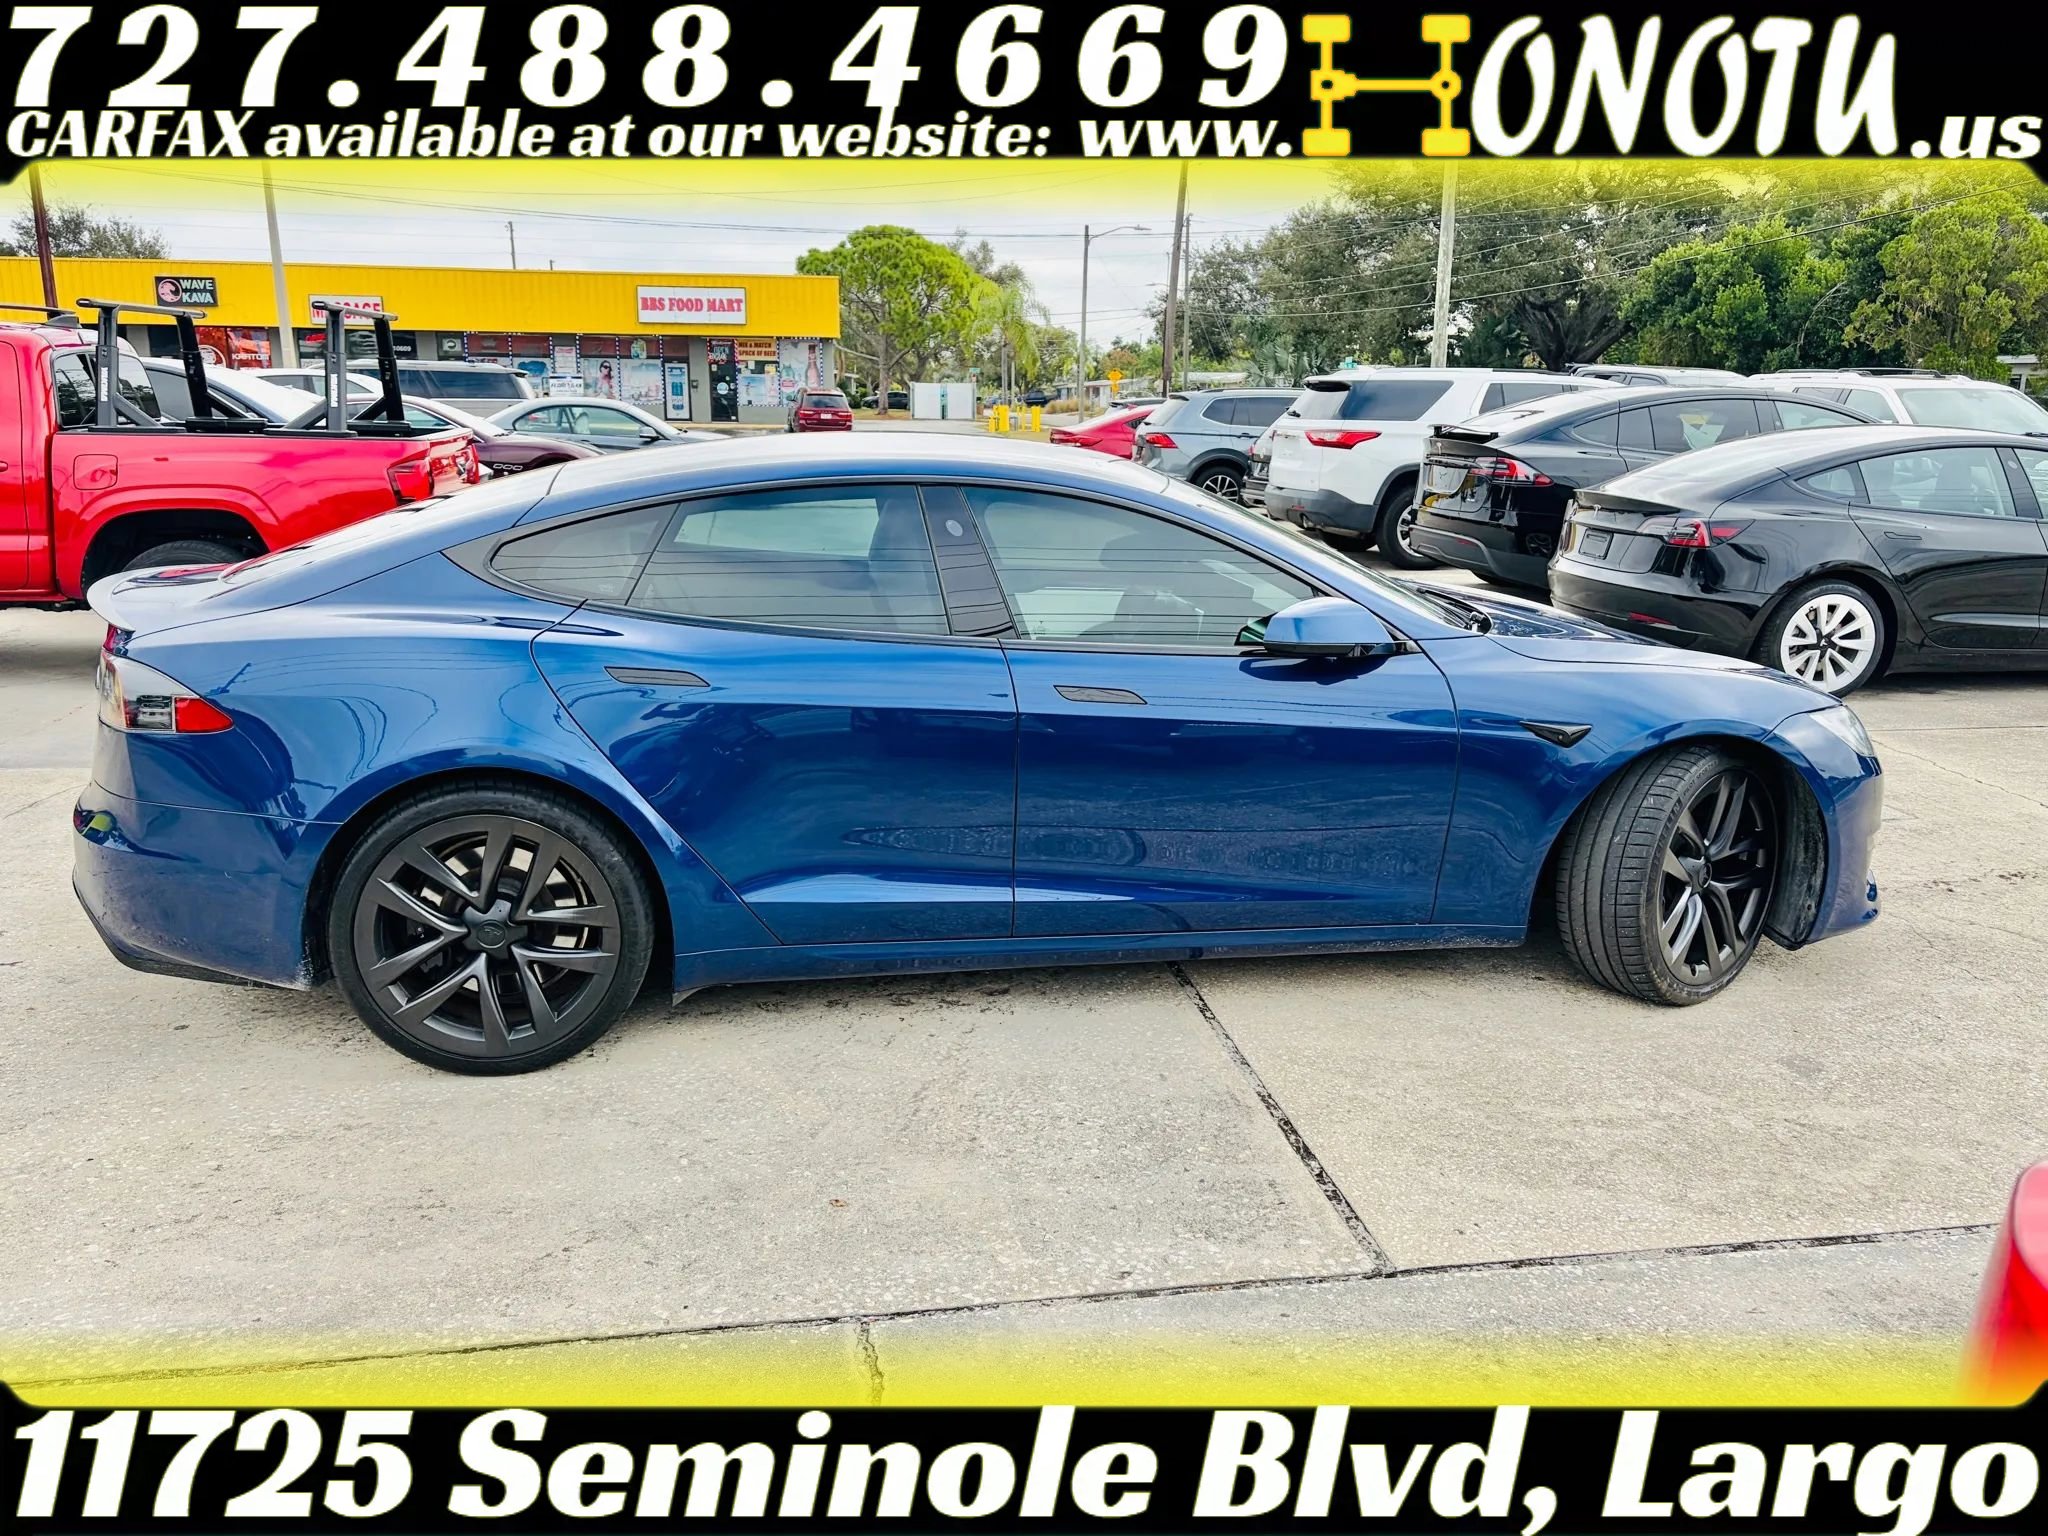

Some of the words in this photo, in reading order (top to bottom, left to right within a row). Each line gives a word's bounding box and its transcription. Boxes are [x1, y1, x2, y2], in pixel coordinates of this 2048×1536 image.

[180, 279, 214, 290] WAVE
[182, 292, 214, 303] KAVA
[640, 297, 665, 311] BBS
[668, 297, 704, 312] FOOD
[706, 298, 743, 312] MART
